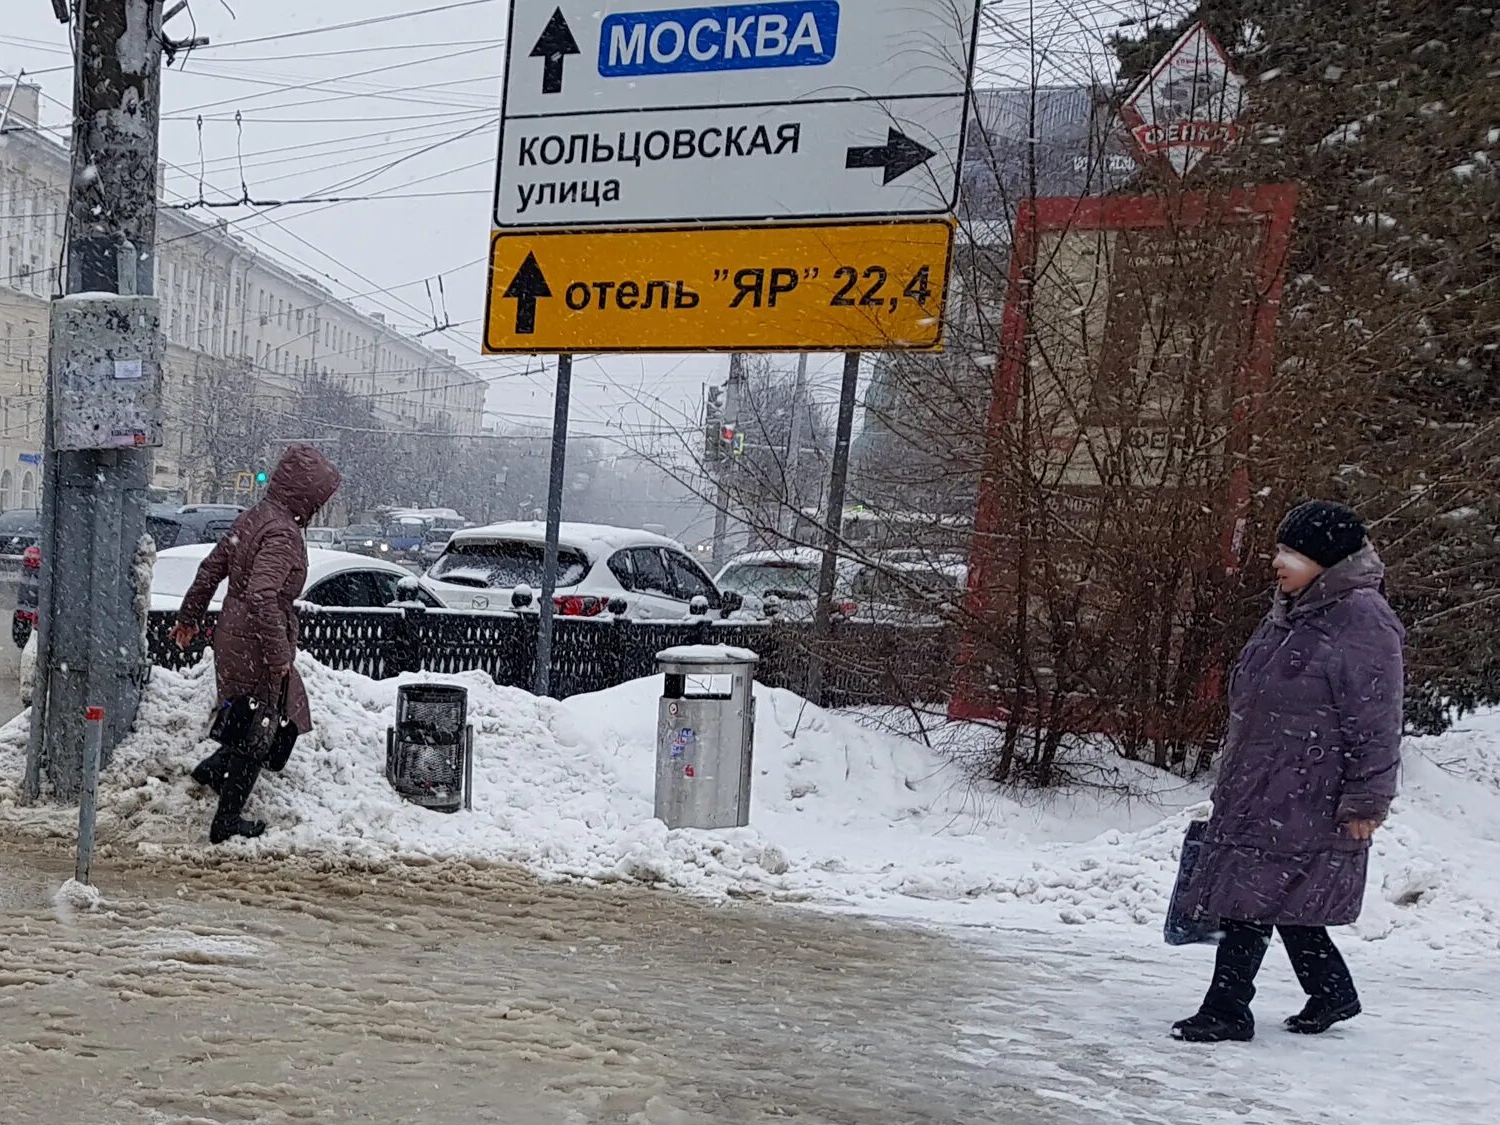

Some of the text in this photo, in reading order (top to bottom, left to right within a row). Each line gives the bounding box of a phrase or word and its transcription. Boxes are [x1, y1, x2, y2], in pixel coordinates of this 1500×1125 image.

[608, 11, 825, 67] МОСКВА
[517, 122, 802, 168] КОЛЬЦОВСКАЯ
[516, 178, 621, 214] улица
[564, 279, 701, 311] отель
[829, 264, 932, 314] 22,4
